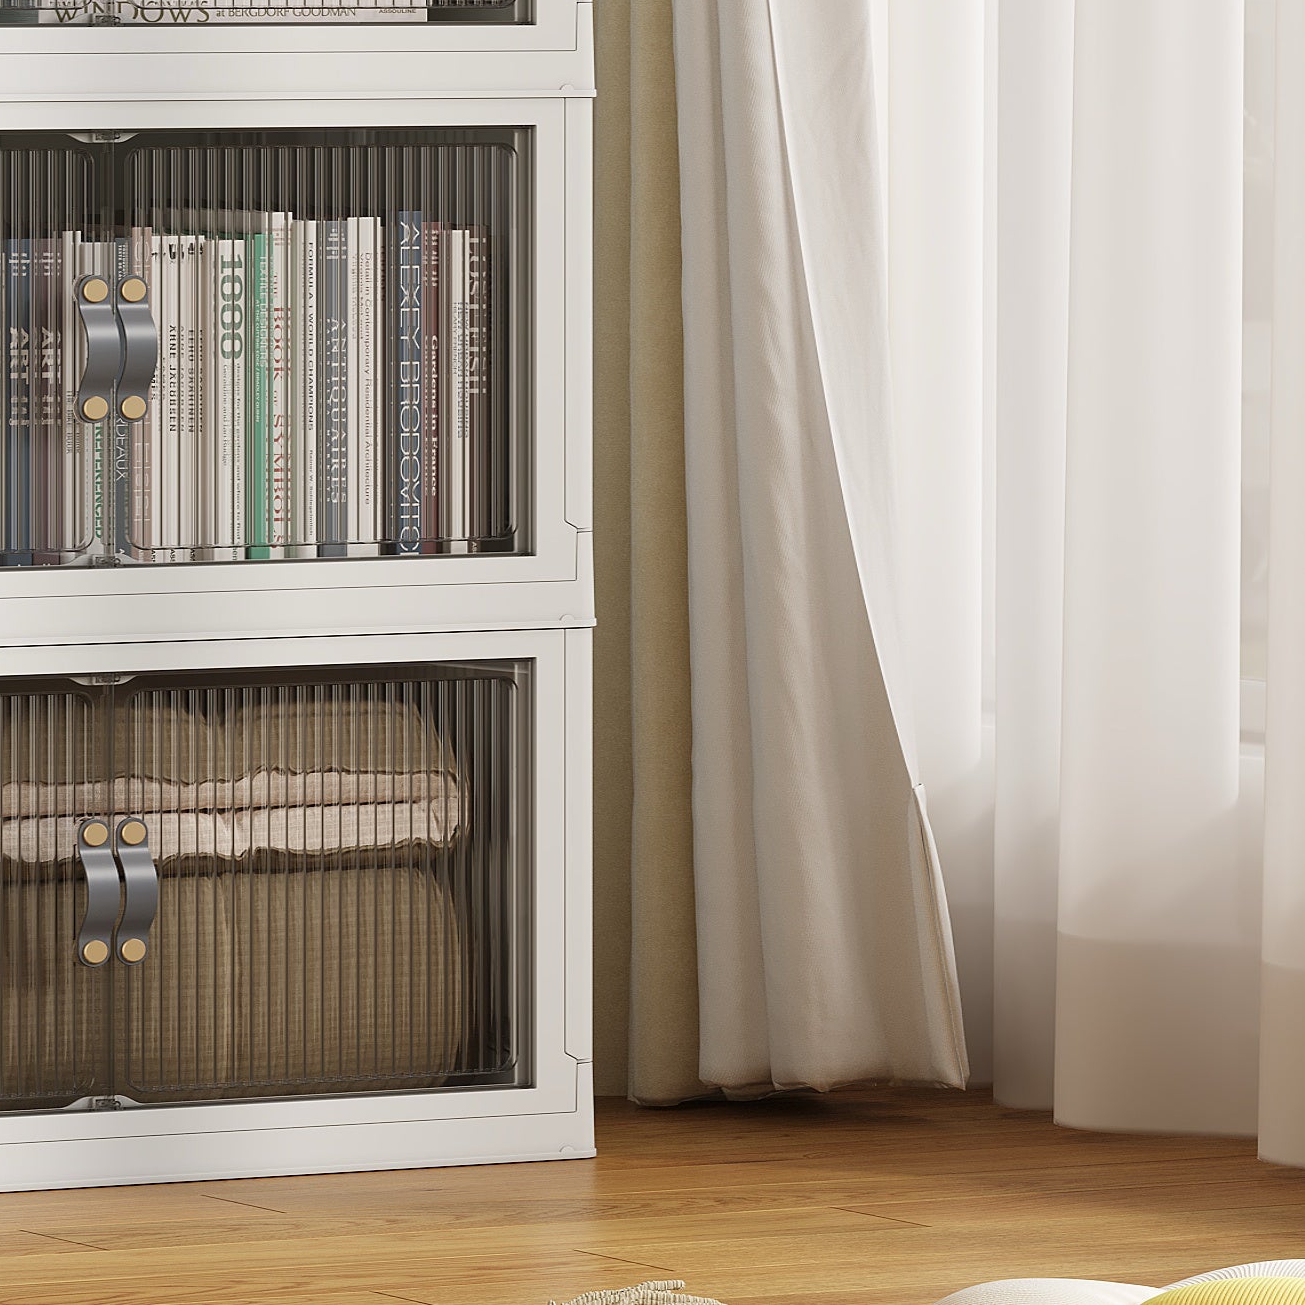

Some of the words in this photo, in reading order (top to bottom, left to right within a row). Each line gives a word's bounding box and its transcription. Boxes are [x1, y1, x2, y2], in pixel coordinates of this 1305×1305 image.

[216, 9, 226, 17] at
[228, 8, 290, 17] BERGDORF
[292, 8, 356, 17] GOODMAN
[259, 256, 269, 299] TEXTILE
[365, 286, 372, 296] in
[400, 221, 419, 350] ALEXEY
[259, 304, 269, 368] DESIGNERS
[273, 307, 286, 381] BOOK
[364, 299, 372, 374] Contemporary
[115, 413, 128, 481] RDEAUX
[400, 361, 419, 555] BRODOVITC
